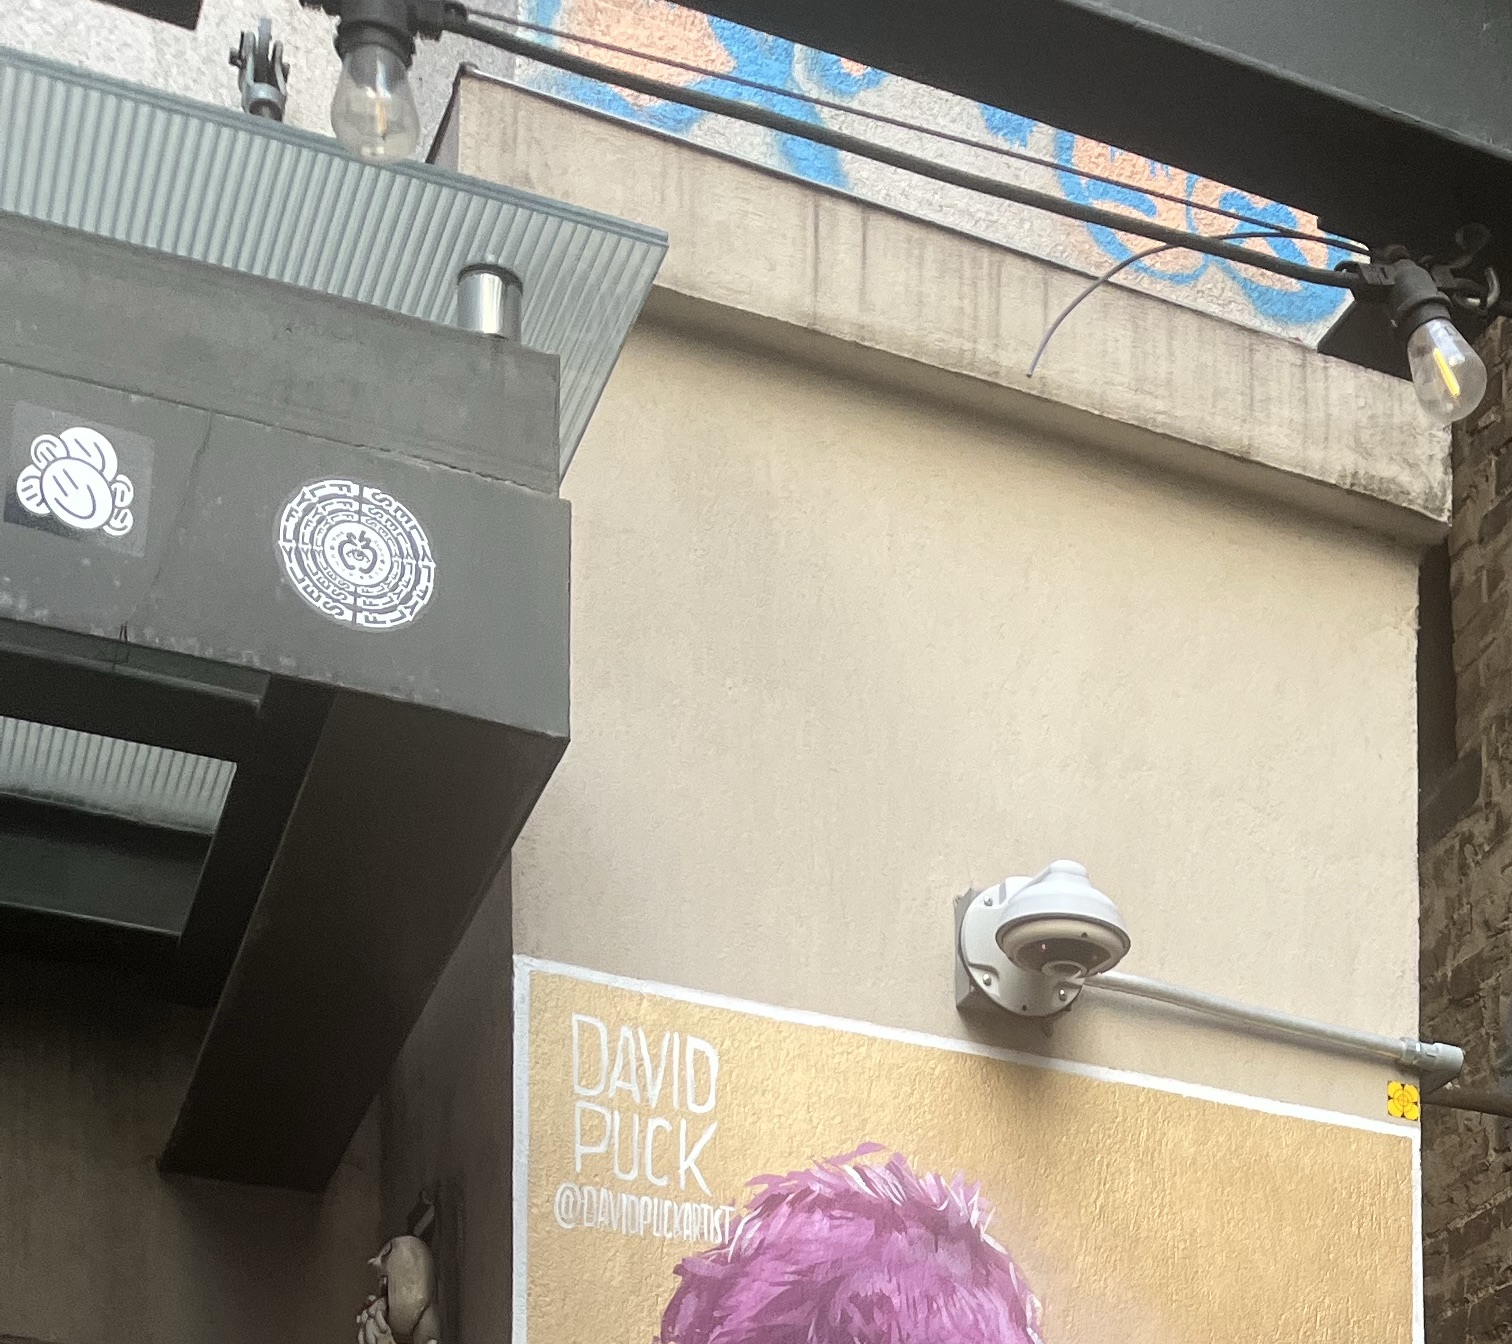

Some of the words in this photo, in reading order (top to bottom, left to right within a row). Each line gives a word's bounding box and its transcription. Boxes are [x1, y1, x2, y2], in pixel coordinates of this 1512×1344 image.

[572, 1013, 719, 1113] DAVID
[575, 1100, 718, 1197] PUCK
[554, 1182, 737, 1244] @DAVIDPUCKARTIST
